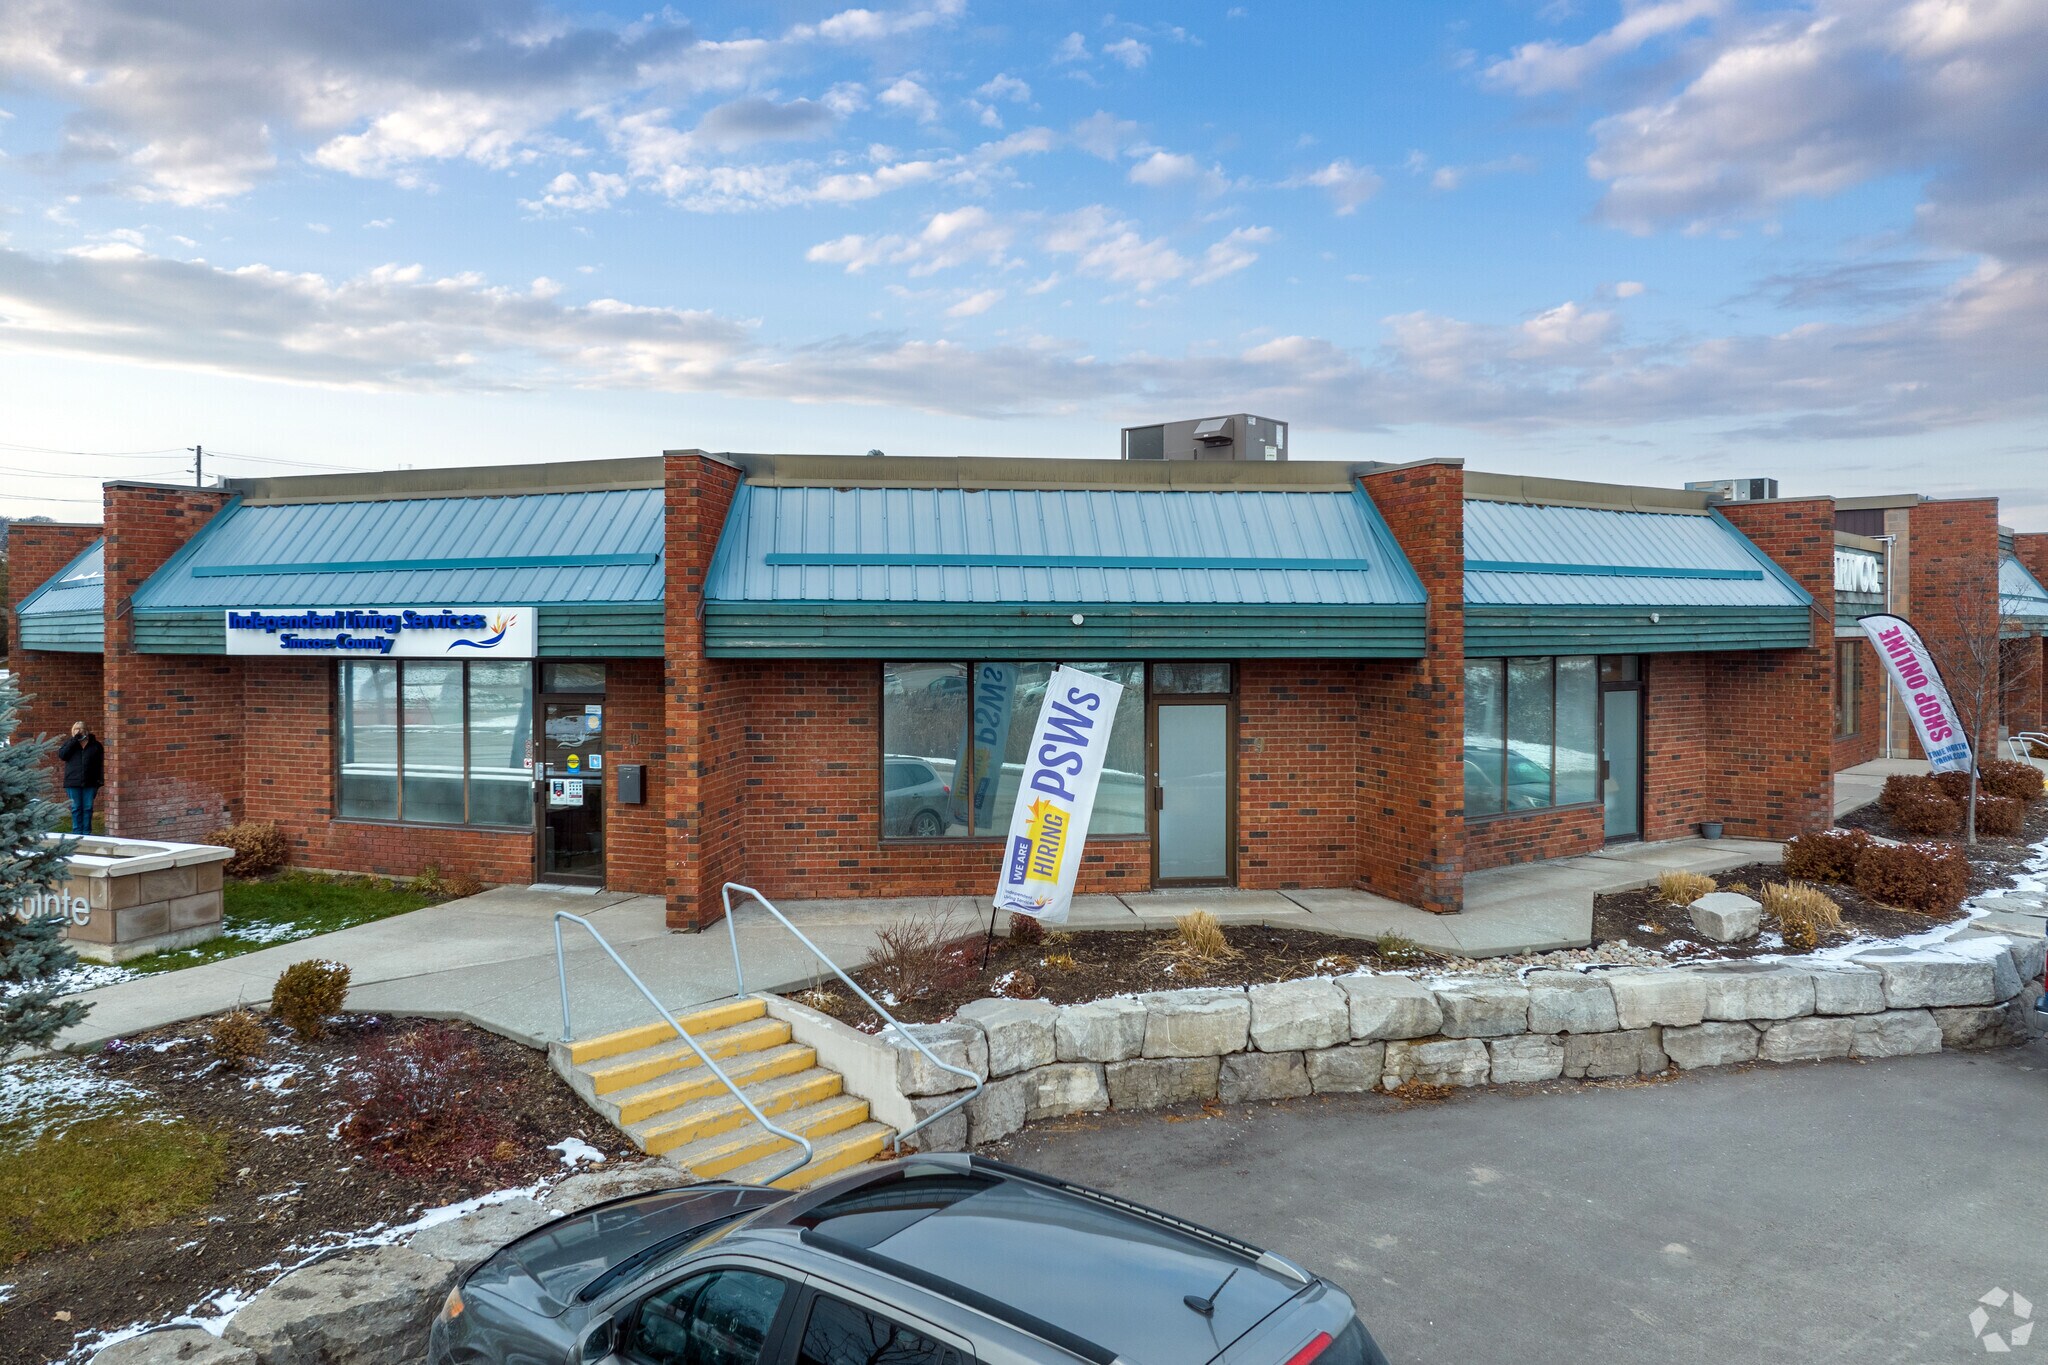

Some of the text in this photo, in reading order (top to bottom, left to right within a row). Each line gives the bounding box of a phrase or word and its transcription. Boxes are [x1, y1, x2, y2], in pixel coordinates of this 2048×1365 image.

[228, 609, 487, 634] Independent Living Services
[280, 633, 396, 654] Simcoe County
[1878, 625, 1953, 742] SHOP ONLINE
[1030, 686, 1101, 802] PSWs
[1928, 748, 1946, 759] TRUE
[1013, 842, 1029, 882] WE ARE
[1033, 813, 1063, 877] HIRING
